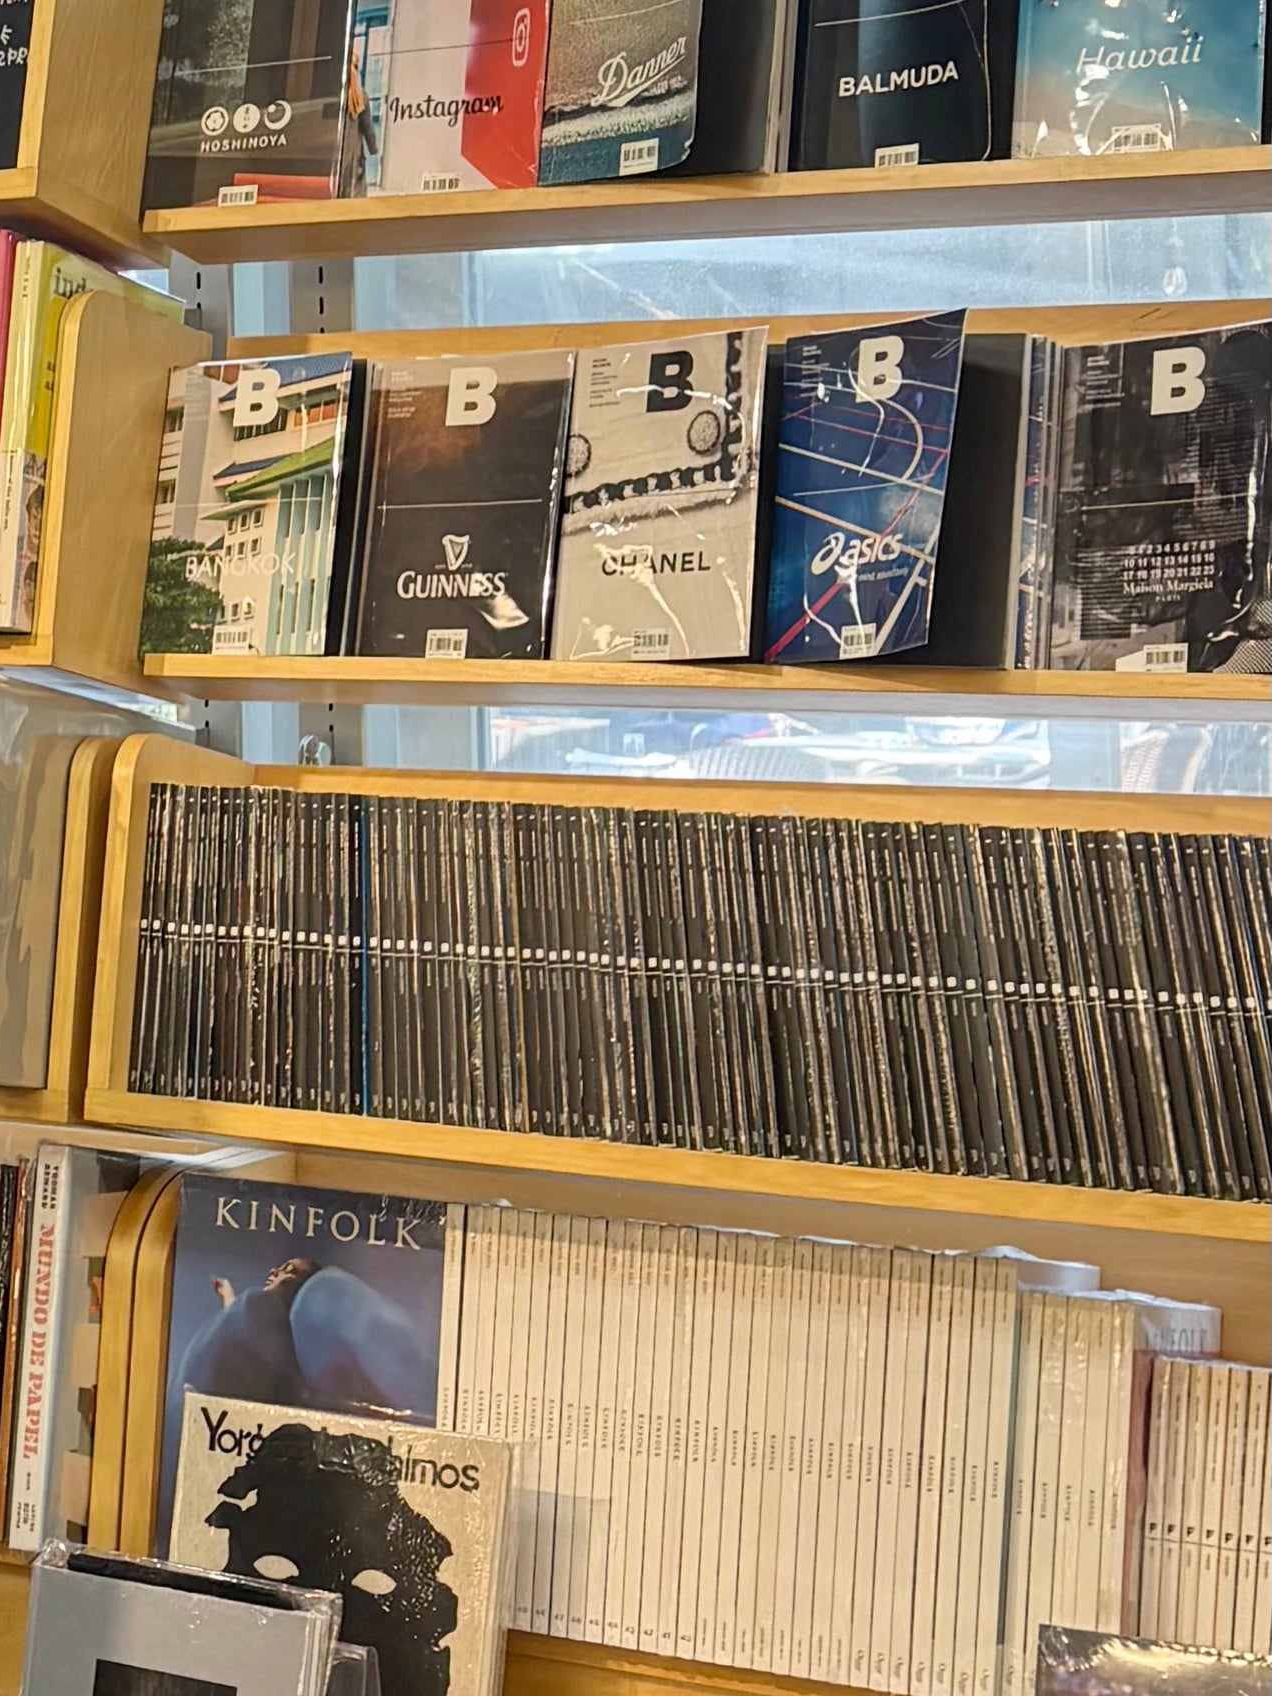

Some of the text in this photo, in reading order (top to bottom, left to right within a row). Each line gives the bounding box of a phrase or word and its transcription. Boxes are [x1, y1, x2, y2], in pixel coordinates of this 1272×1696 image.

[590, 37, 687, 107] Danner
[1077, 36, 1205, 73] Hawaii
[839, 59, 959, 99] BALMUDA
[389, 94, 505, 128] Instagram
[199, 132, 288, 155] HOSHINOYA
[646, 350, 695, 413] B
[856, 335, 905, 403] B
[1151, 346, 1207, 416] B
[233, 367, 282, 427] B
[445, 366, 498, 427] B
[184, 552, 295, 579] BANGKOK
[602, 551, 711, 577] CHANEL
[1124, 558, 1135, 568] 10
[1165, 556, 1175, 565] 13
[1178, 555, 1188, 564] 14
[1191, 554, 1202, 563] 15
[1163, 568, 1175, 578] 20
[1177, 567, 1188, 577] 21
[1190, 566, 1201, 576] 22
[397, 568, 507, 600] GUINNESS
[1123, 578, 1214, 596] Maison Margiela
[215, 1196, 421, 1251] KINFOLK
[33, 1223, 56, 1326] MUNDO
[29, 1330, 49, 1366] DE
[21, 1371, 45, 1460] PAPEL
